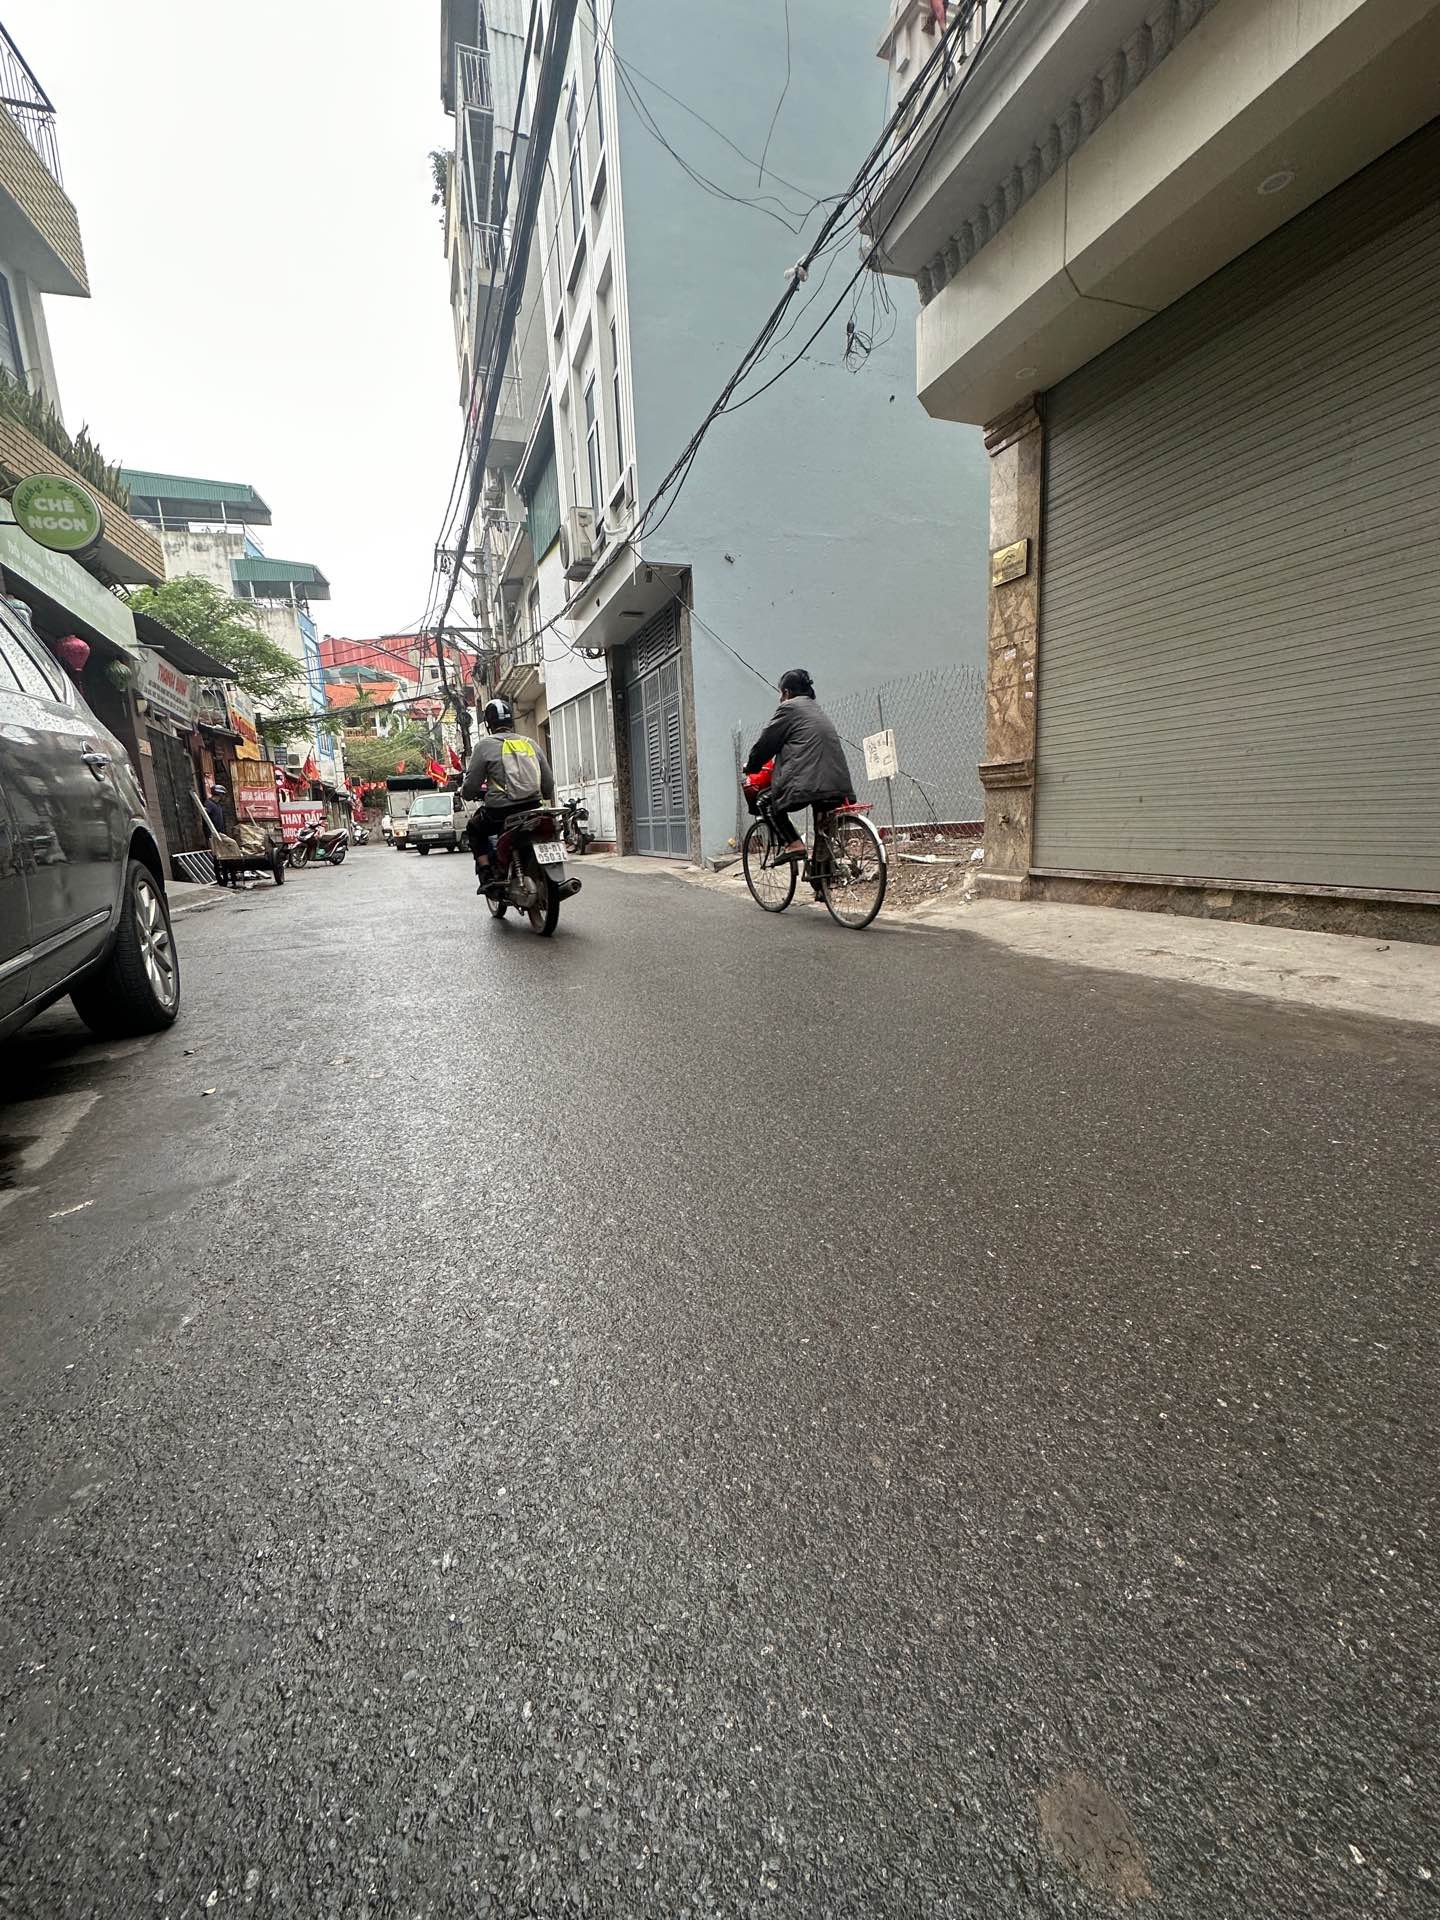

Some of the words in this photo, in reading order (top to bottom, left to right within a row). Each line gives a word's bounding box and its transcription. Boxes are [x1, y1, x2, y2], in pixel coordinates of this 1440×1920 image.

[33, 496, 75, 512] CHÈ
[27, 515, 88, 532] NGON
[280, 814, 302, 825] THAY
